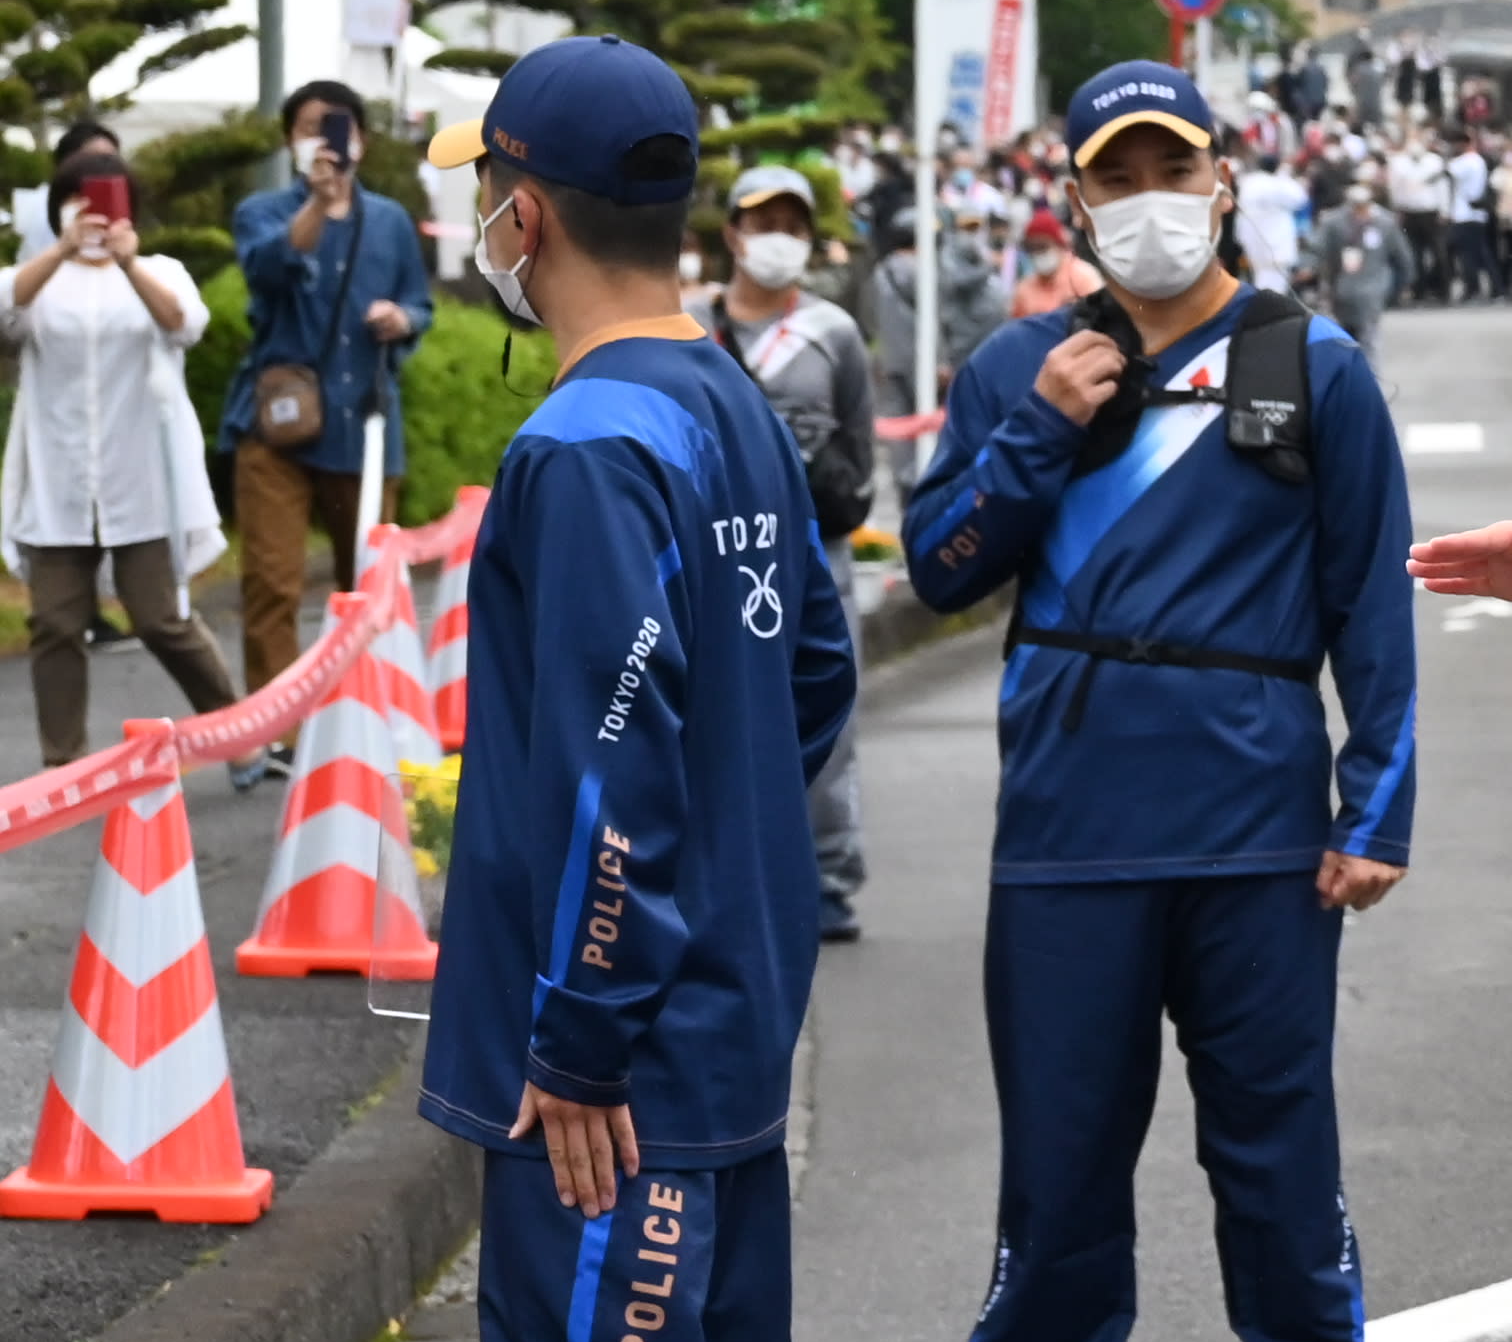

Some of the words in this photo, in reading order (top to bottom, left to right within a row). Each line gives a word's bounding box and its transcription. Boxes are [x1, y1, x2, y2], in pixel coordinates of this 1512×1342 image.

[597, 671, 641, 742] TOKYO
[626, 616, 661, 672] 2020
[581, 825, 630, 970] POLICE
